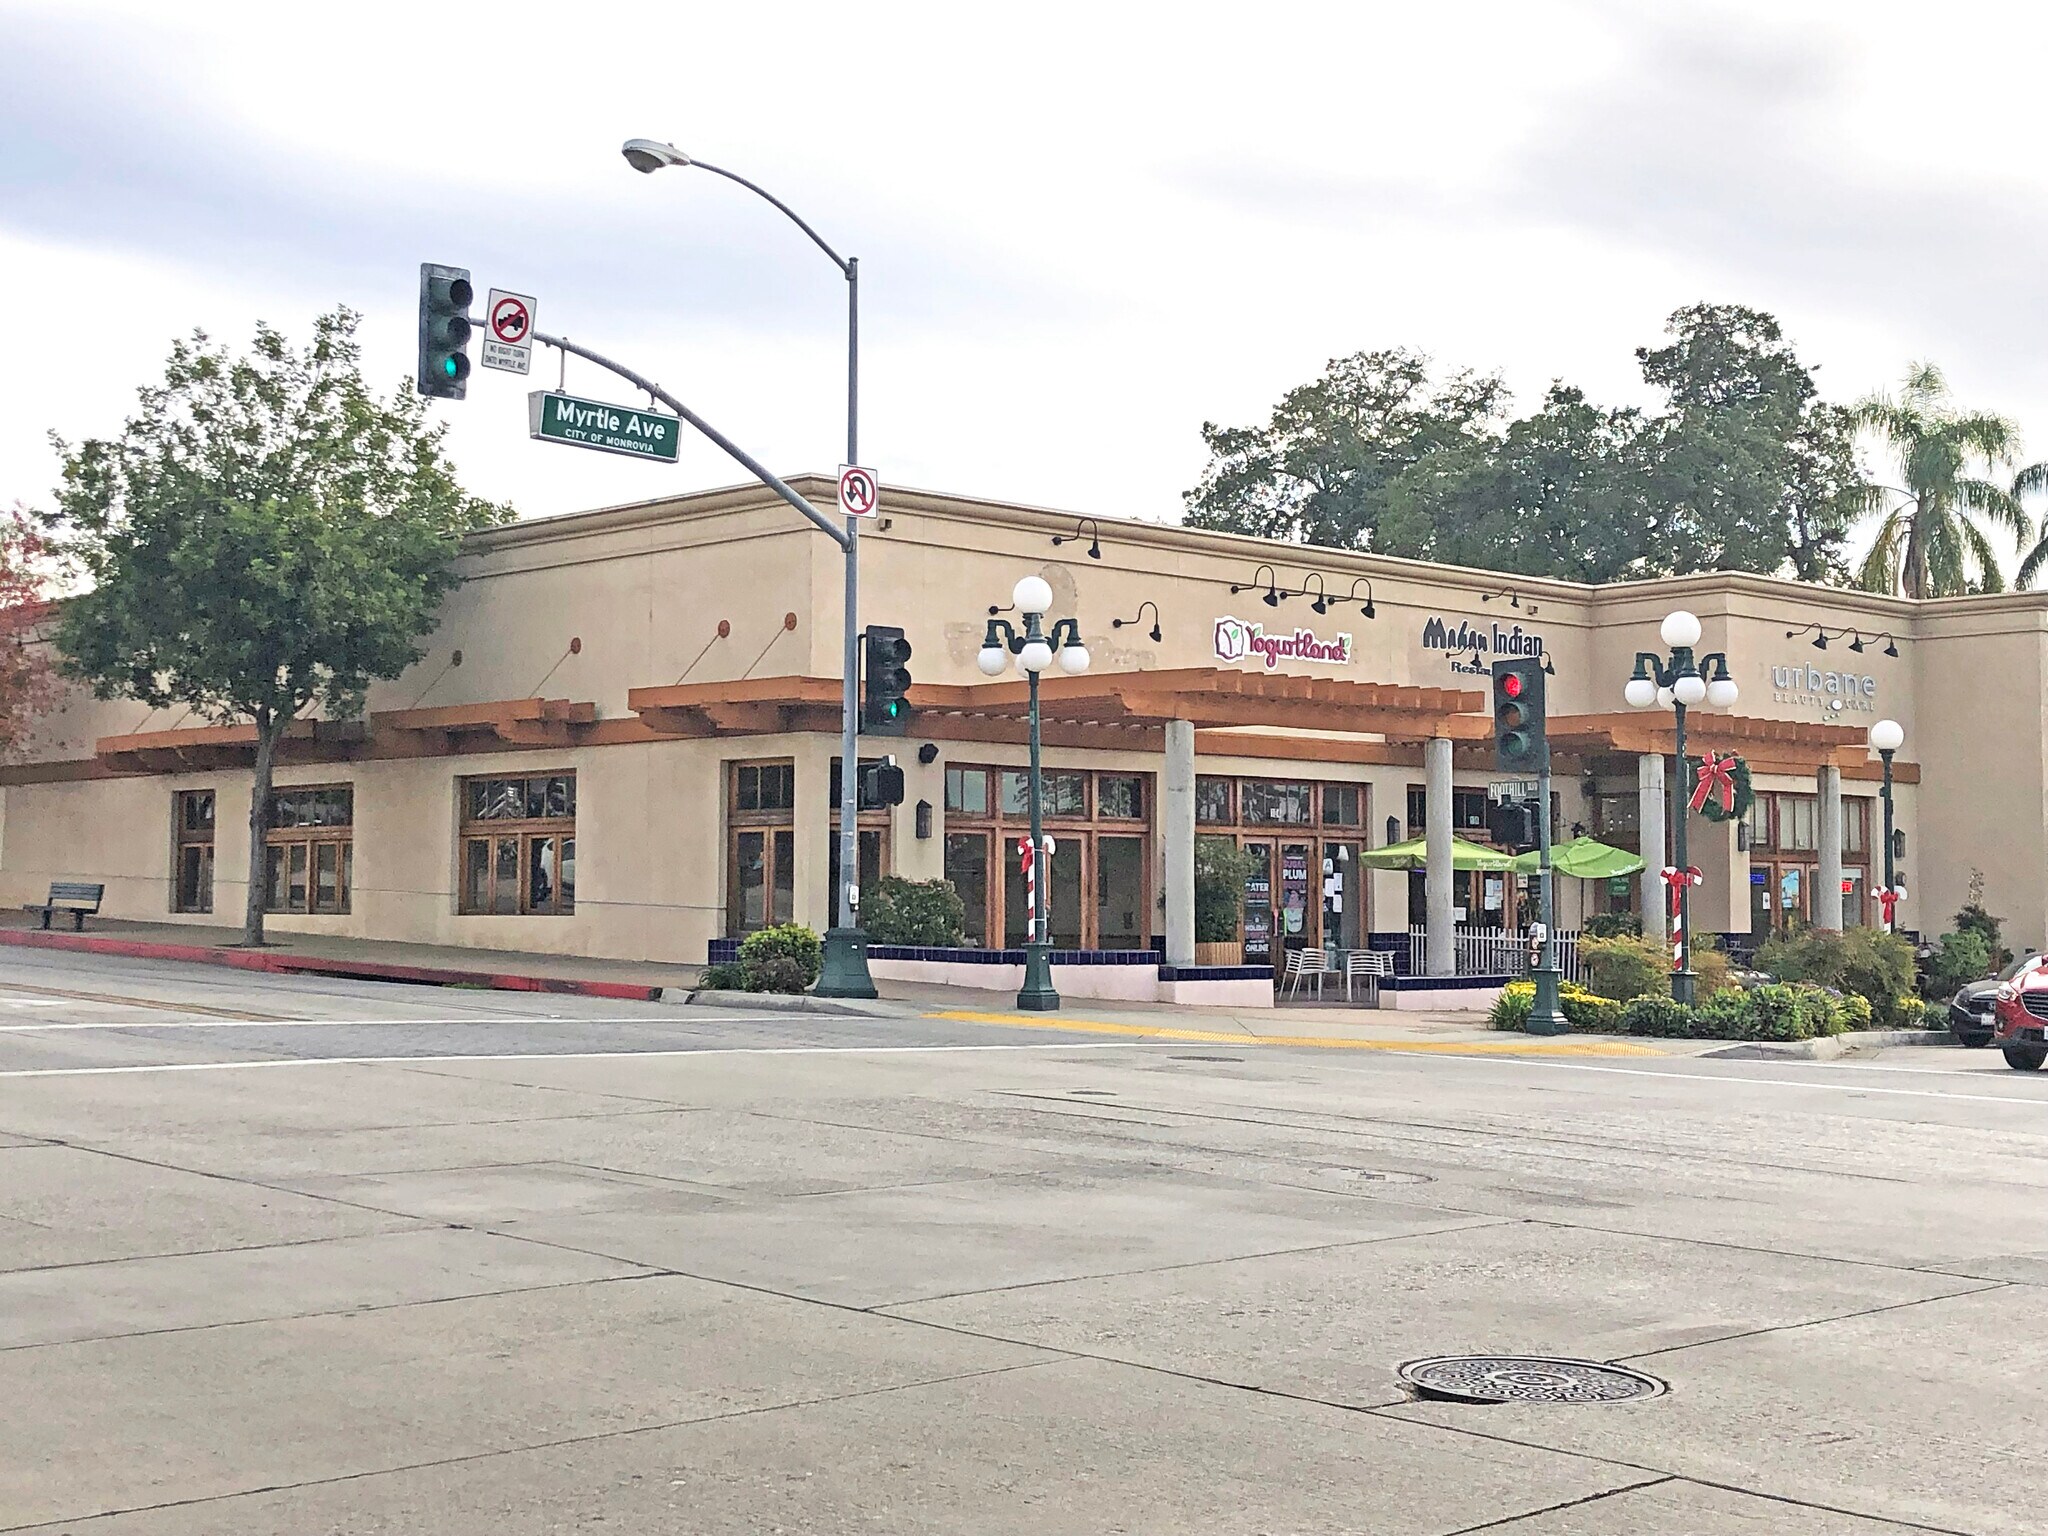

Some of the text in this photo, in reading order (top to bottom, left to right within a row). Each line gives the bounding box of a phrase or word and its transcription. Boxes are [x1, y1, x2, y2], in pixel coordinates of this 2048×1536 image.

[556, 399, 666, 441] Myrtle Ave
[565, 428, 655, 453] CITY OF MONROVIA
[1245, 625, 1347, 668] Yogurtland
[1492, 622, 1543, 657] Indian
[1771, 661, 1876, 698] urbane
[1773, 692, 1825, 707] BEAUTY
[1490, 782, 1526, 798] FOOTHILL
[1282, 868, 1307, 880] PLUM
[1245, 943, 1269, 952] ONLINE
